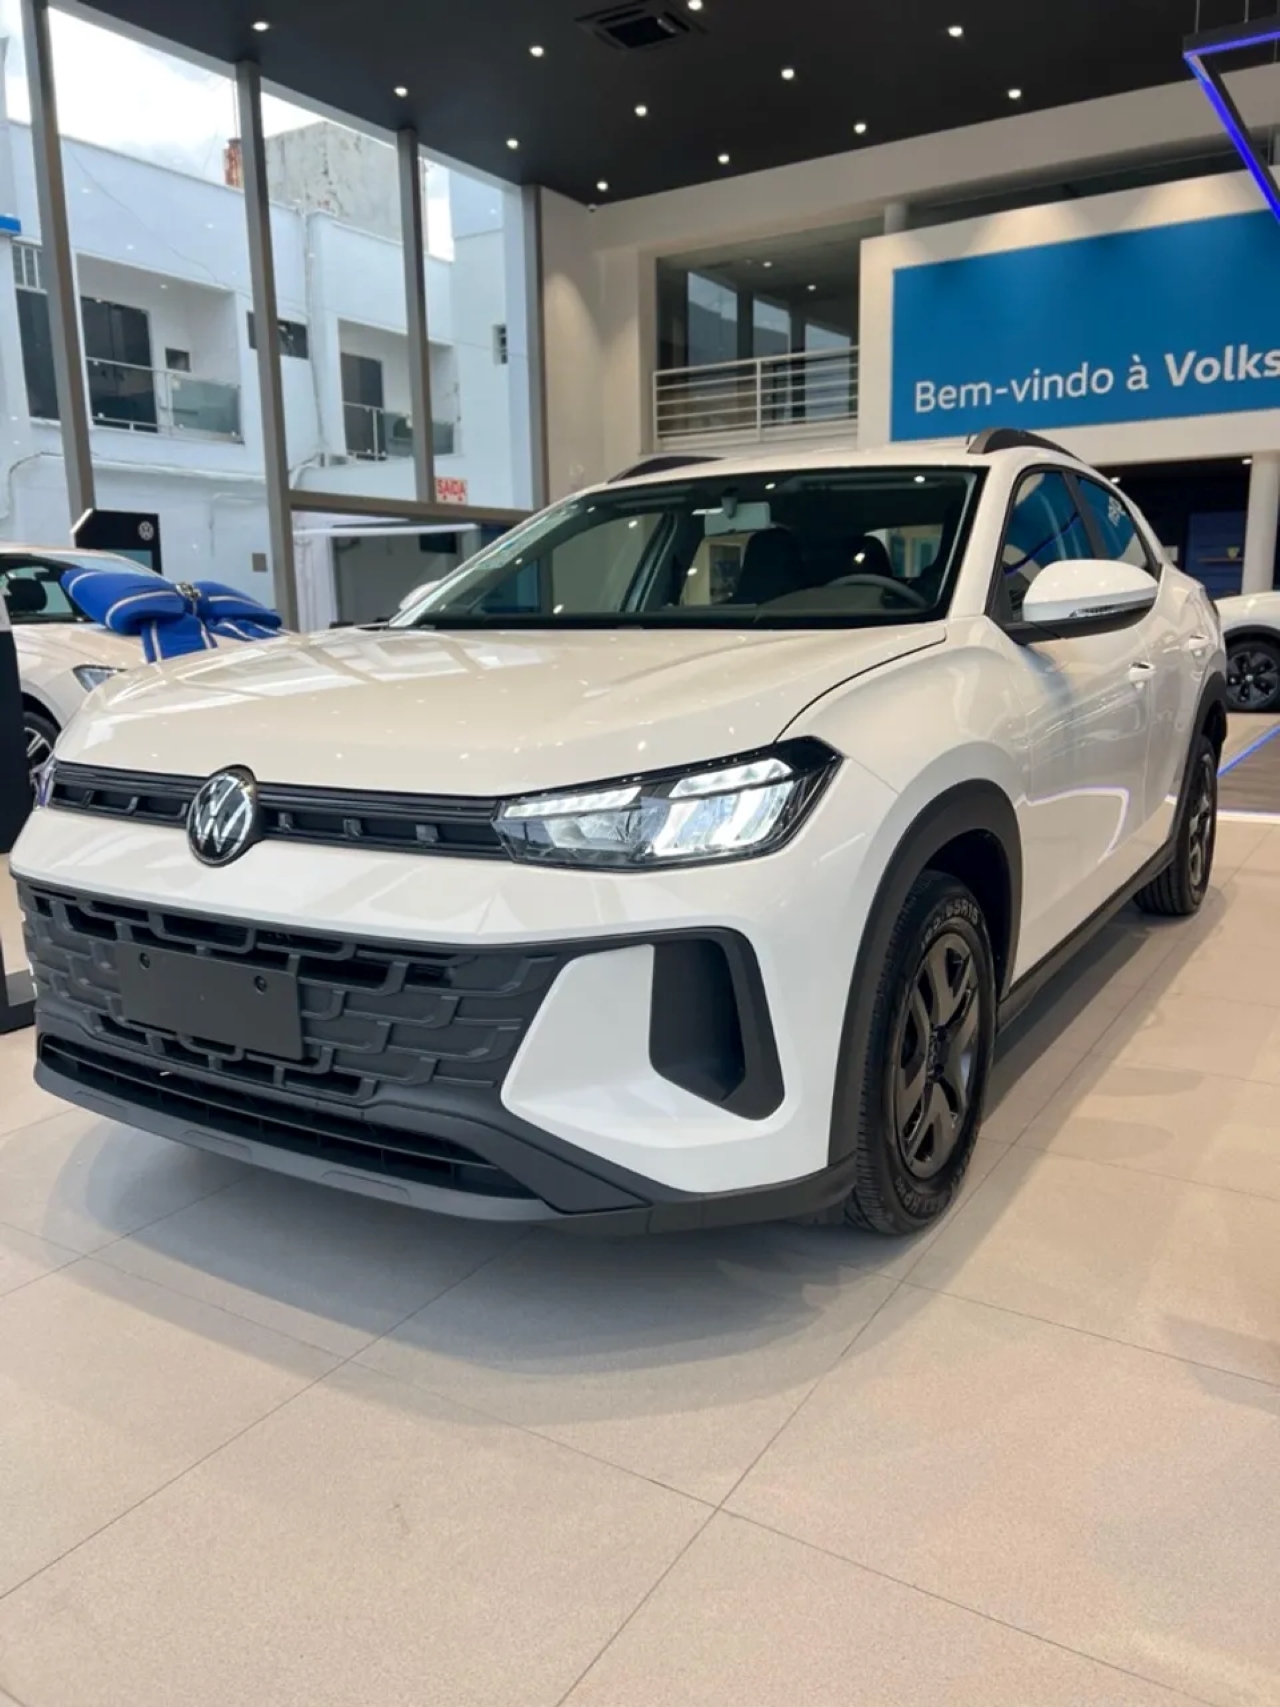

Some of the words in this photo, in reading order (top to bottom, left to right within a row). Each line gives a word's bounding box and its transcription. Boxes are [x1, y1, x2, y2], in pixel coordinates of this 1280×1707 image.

[914, 361, 1114, 413] Bem-vindo
[1126, 354, 1149, 391] à
[1164, 344, 1280, 387] Volks
